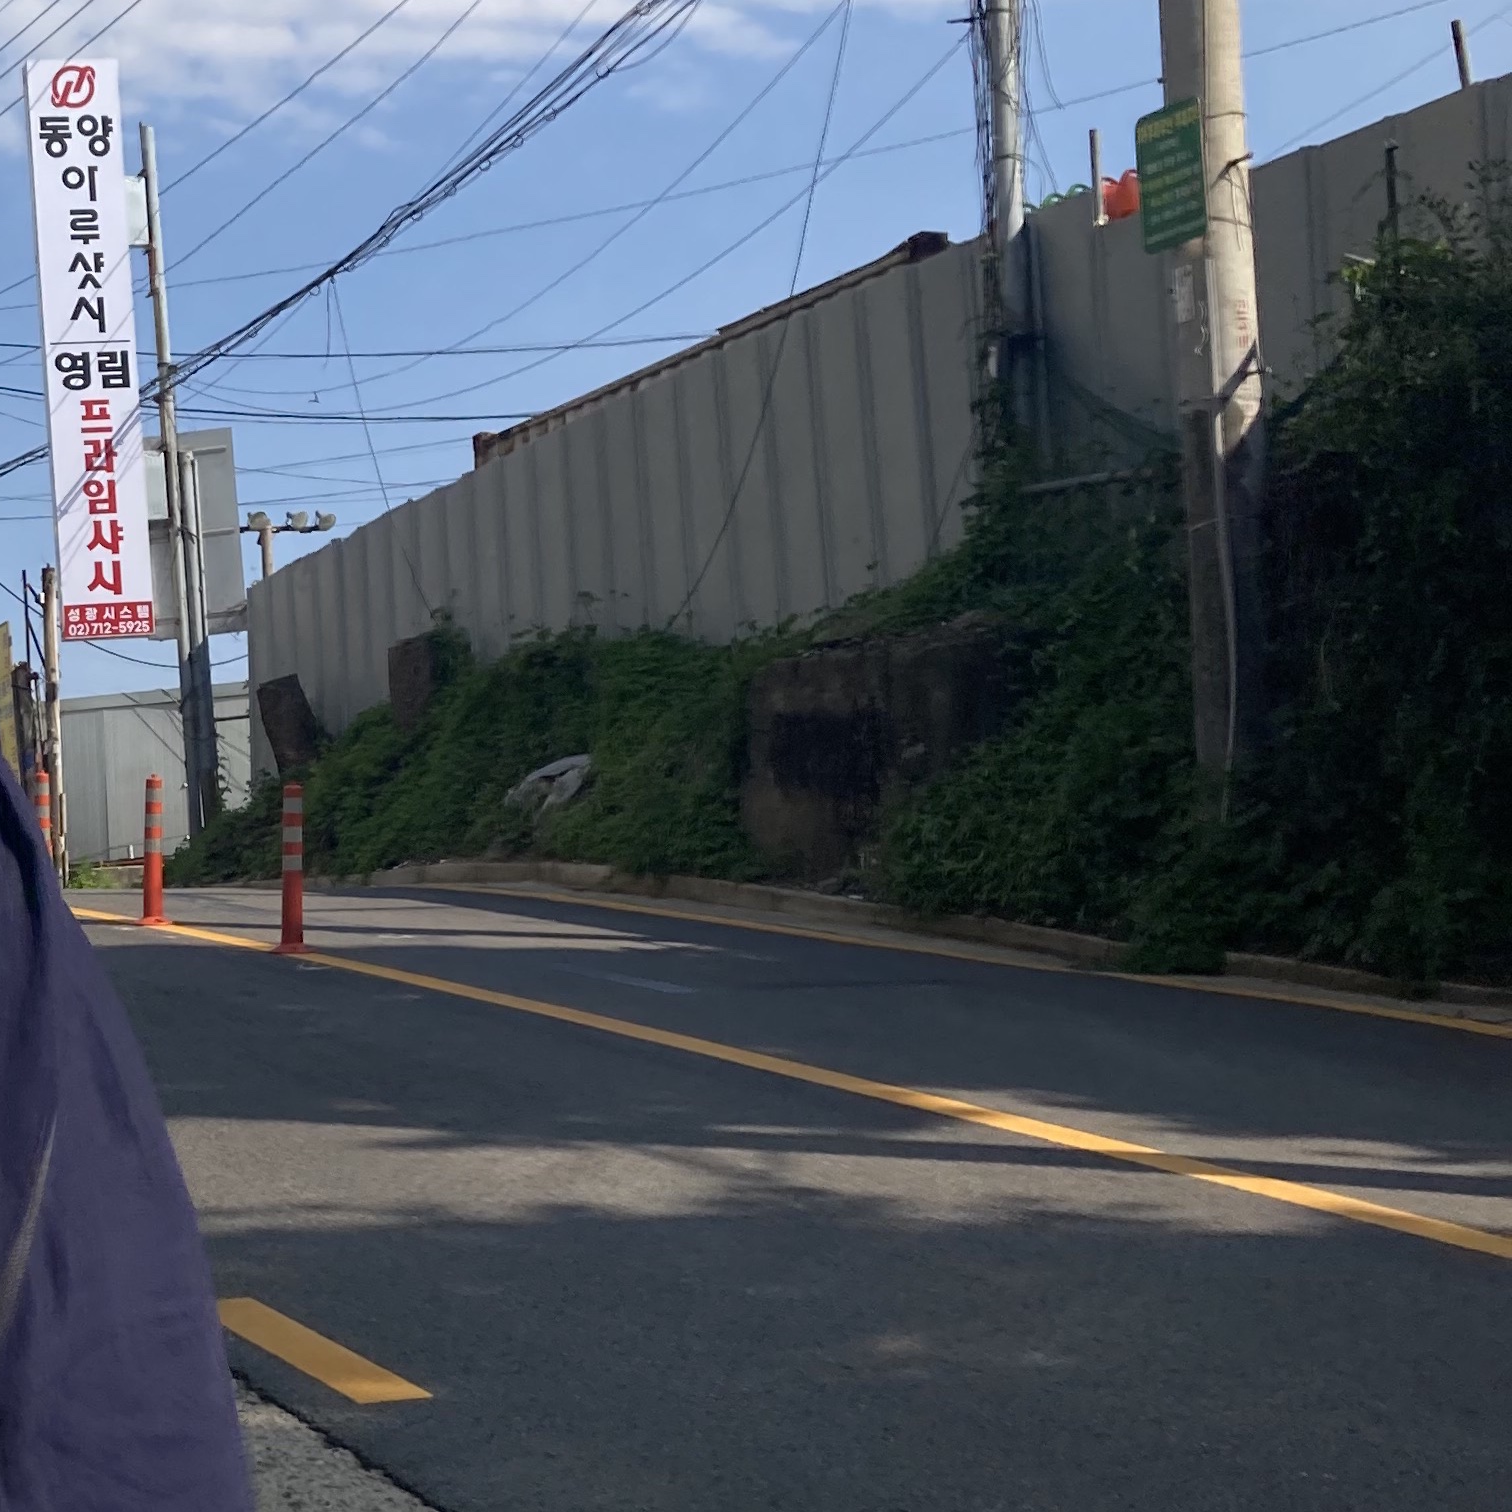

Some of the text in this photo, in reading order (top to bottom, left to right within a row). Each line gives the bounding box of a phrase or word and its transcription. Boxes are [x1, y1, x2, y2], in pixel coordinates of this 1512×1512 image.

[39, 115, 113, 158] 동양
[61, 165, 106, 333] 아루샷시
[54, 350, 132, 391] 영림
[79, 398, 124, 596] 프라임샤시
[68, 621, 151, 636] 02)712-5925
